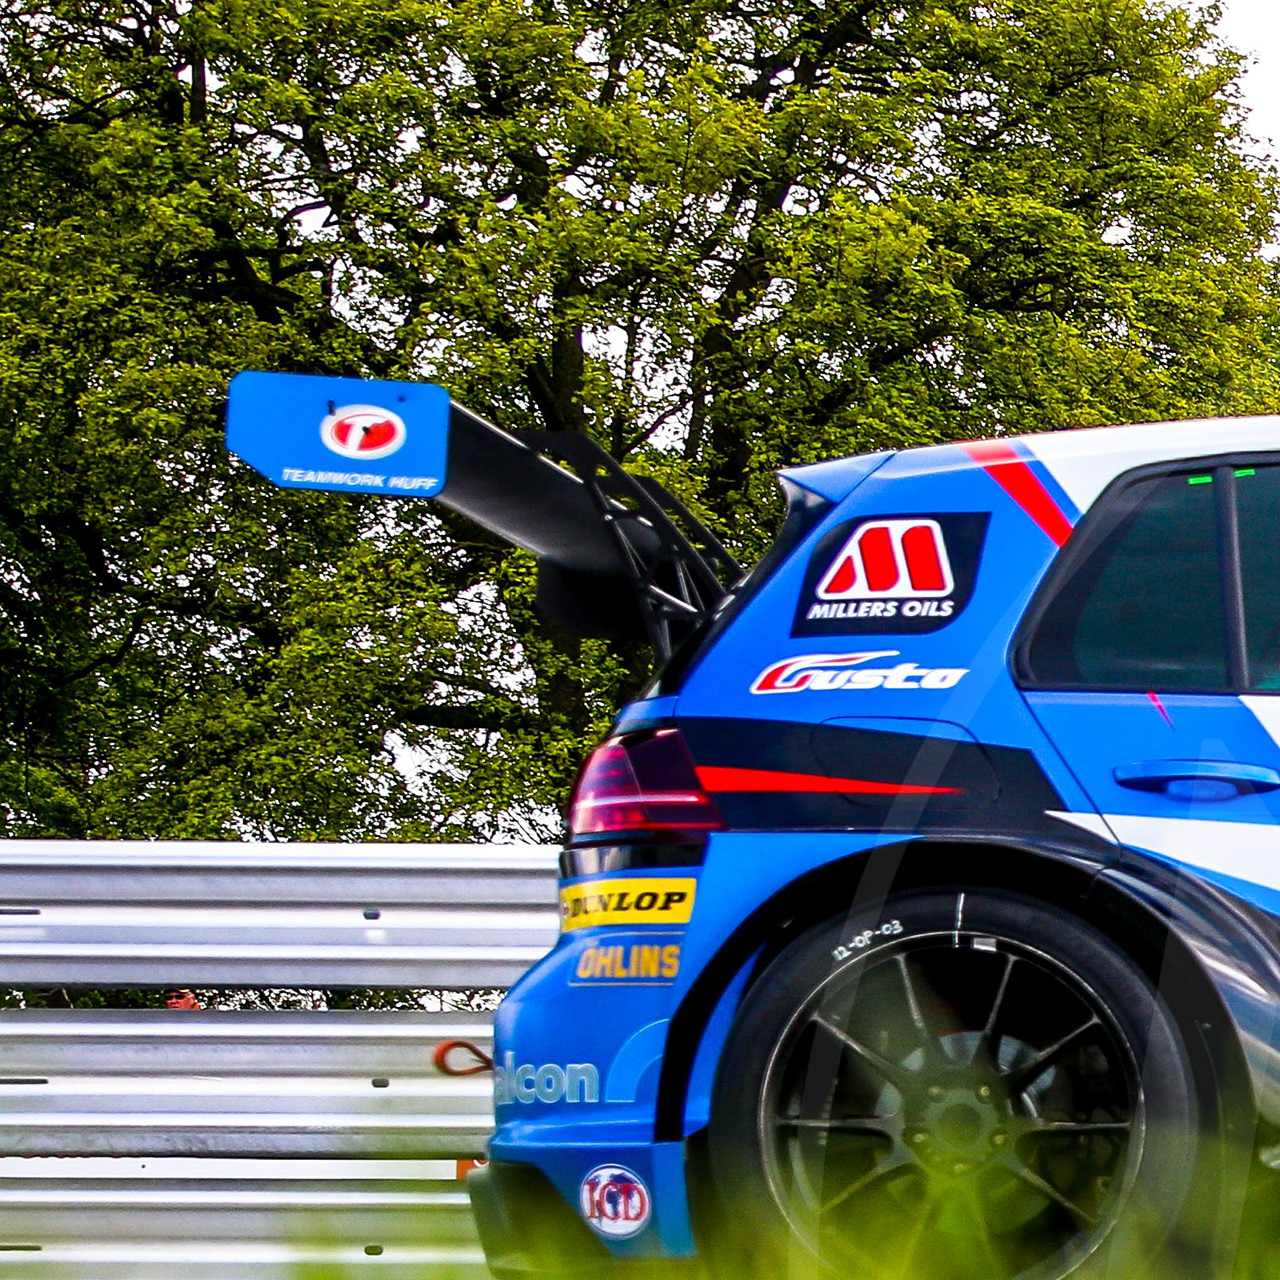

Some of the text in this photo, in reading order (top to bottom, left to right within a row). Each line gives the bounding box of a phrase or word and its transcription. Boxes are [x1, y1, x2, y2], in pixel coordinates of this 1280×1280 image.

[282, 467, 440, 491] TEAMWORK HUFF
[806, 599, 956, 620] MILLERS OILS
[750, 650, 971, 695] Gusto
[571, 891, 688, 918] DUNLOP
